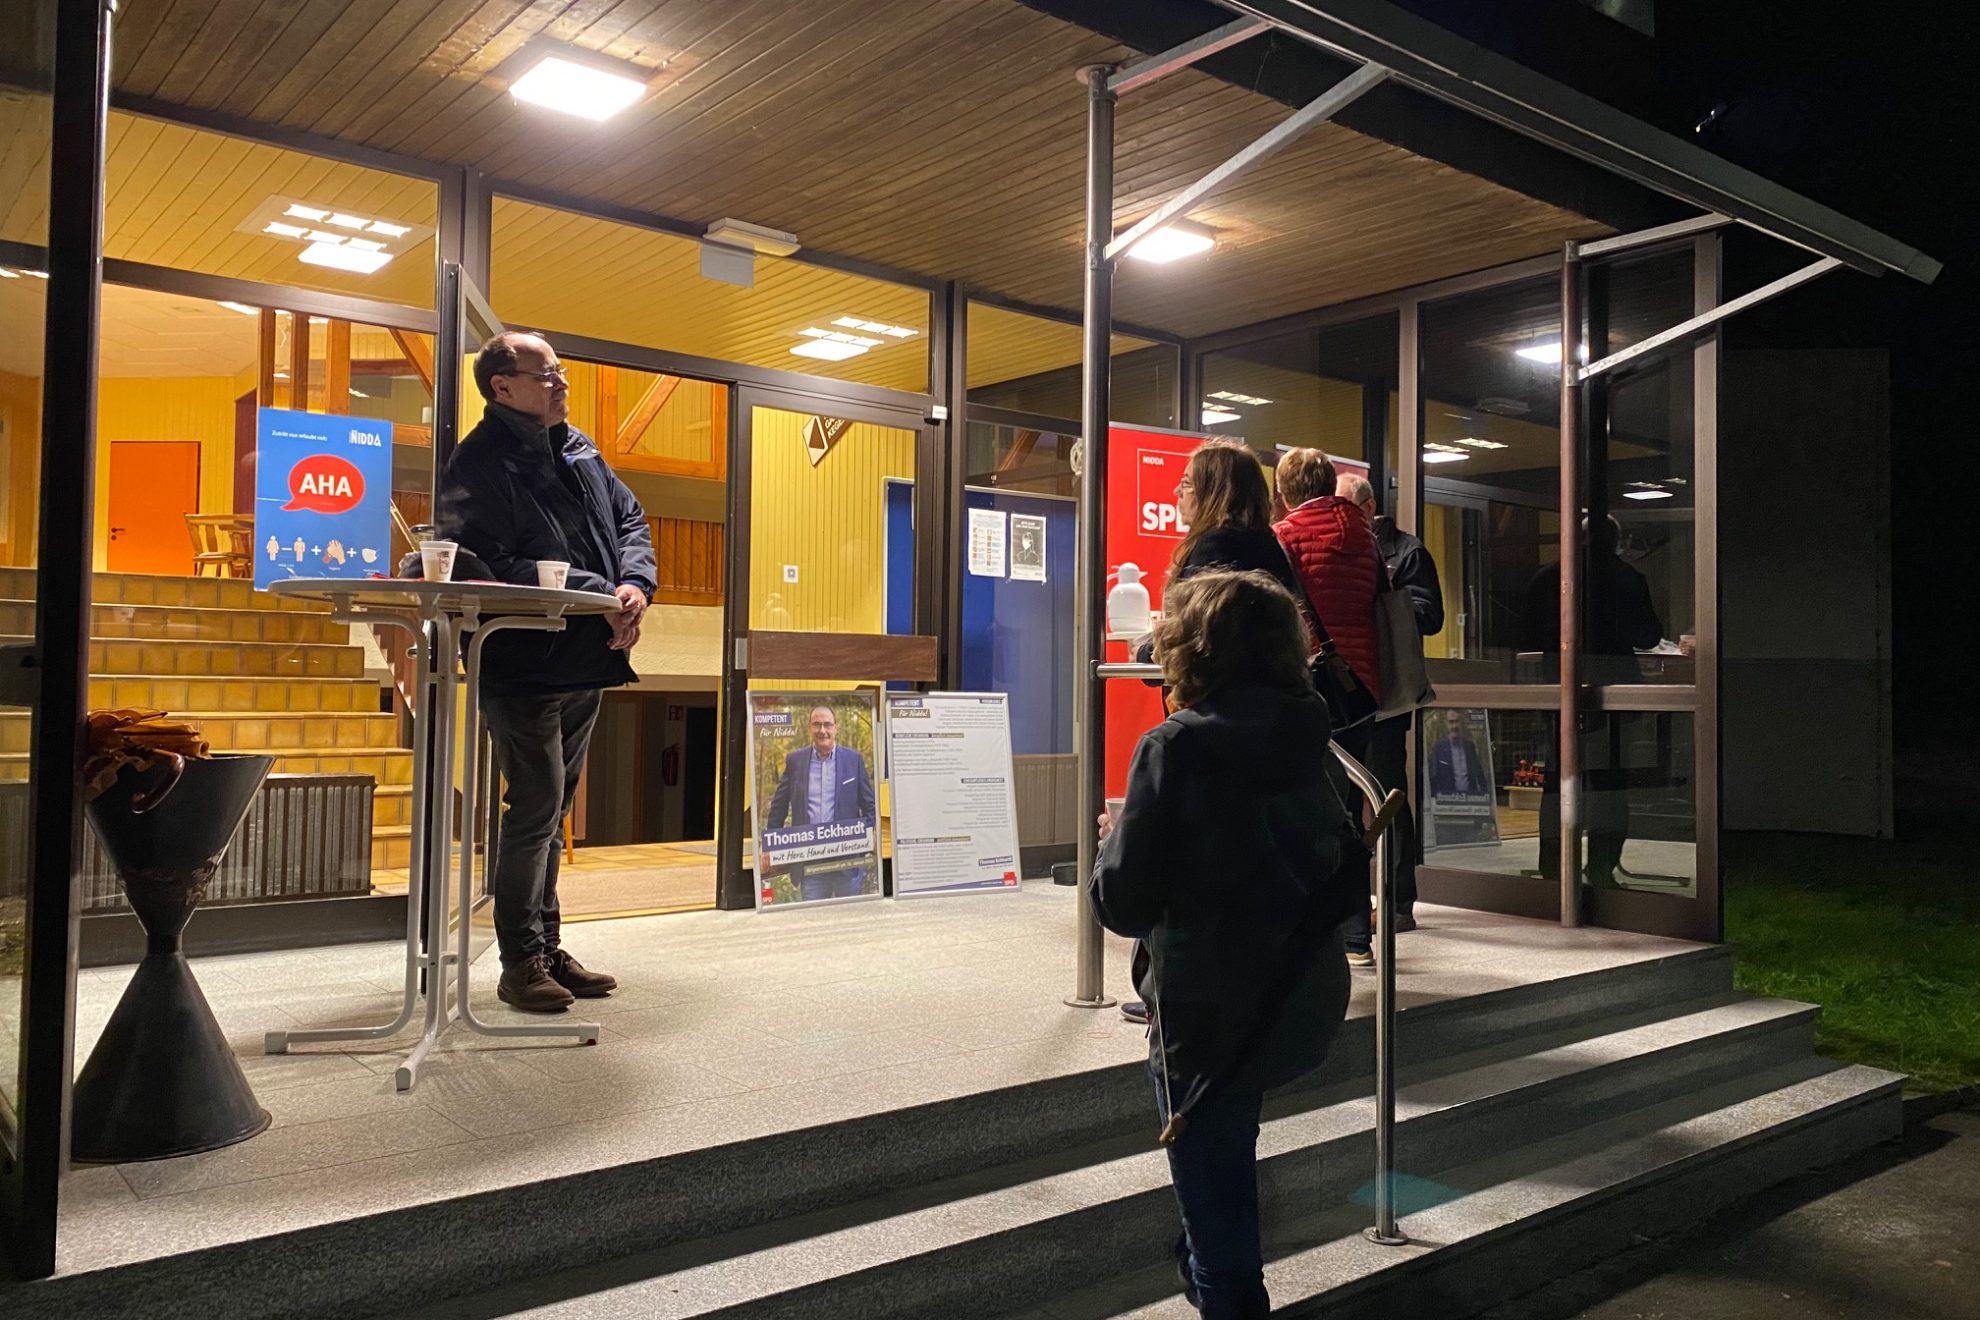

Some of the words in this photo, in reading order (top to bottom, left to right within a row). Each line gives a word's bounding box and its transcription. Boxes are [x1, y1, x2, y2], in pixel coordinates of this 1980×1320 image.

[1143, 456, 1164, 466] NIDDA
[298, 472, 353, 498] AHA
[754, 714, 787, 723] KOMPETENT
[764, 831, 814, 846] Thomas
[817, 821, 865, 839] Eckhardt
[807, 847, 826, 857] Hand
[827, 844, 839, 853] und
